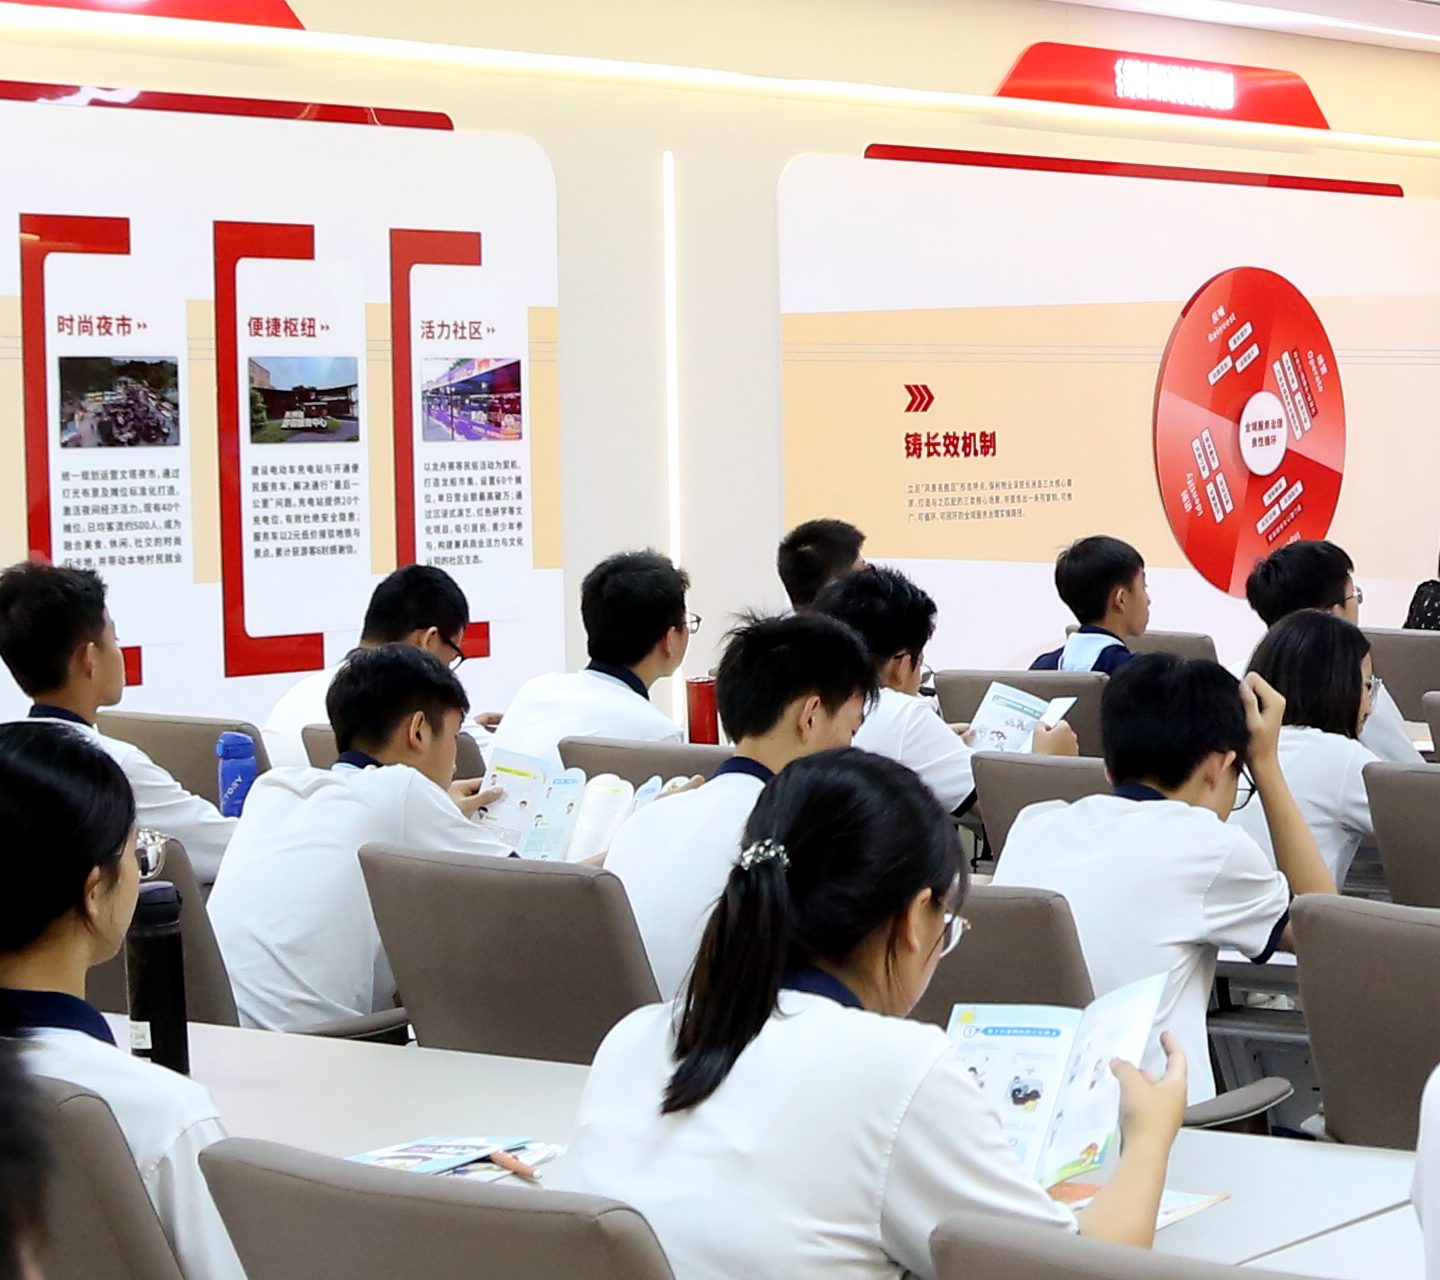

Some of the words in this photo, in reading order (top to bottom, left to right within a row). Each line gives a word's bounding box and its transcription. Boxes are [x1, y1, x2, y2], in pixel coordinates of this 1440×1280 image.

[57, 314, 133, 337] 时尚夜市
[247, 316, 317, 338] 便捷枢纽
[420, 320, 484, 341] 活力社区
[1244, 417, 1284, 434] 全域服务治理
[904, 430, 997, 459] 铸长效机制
